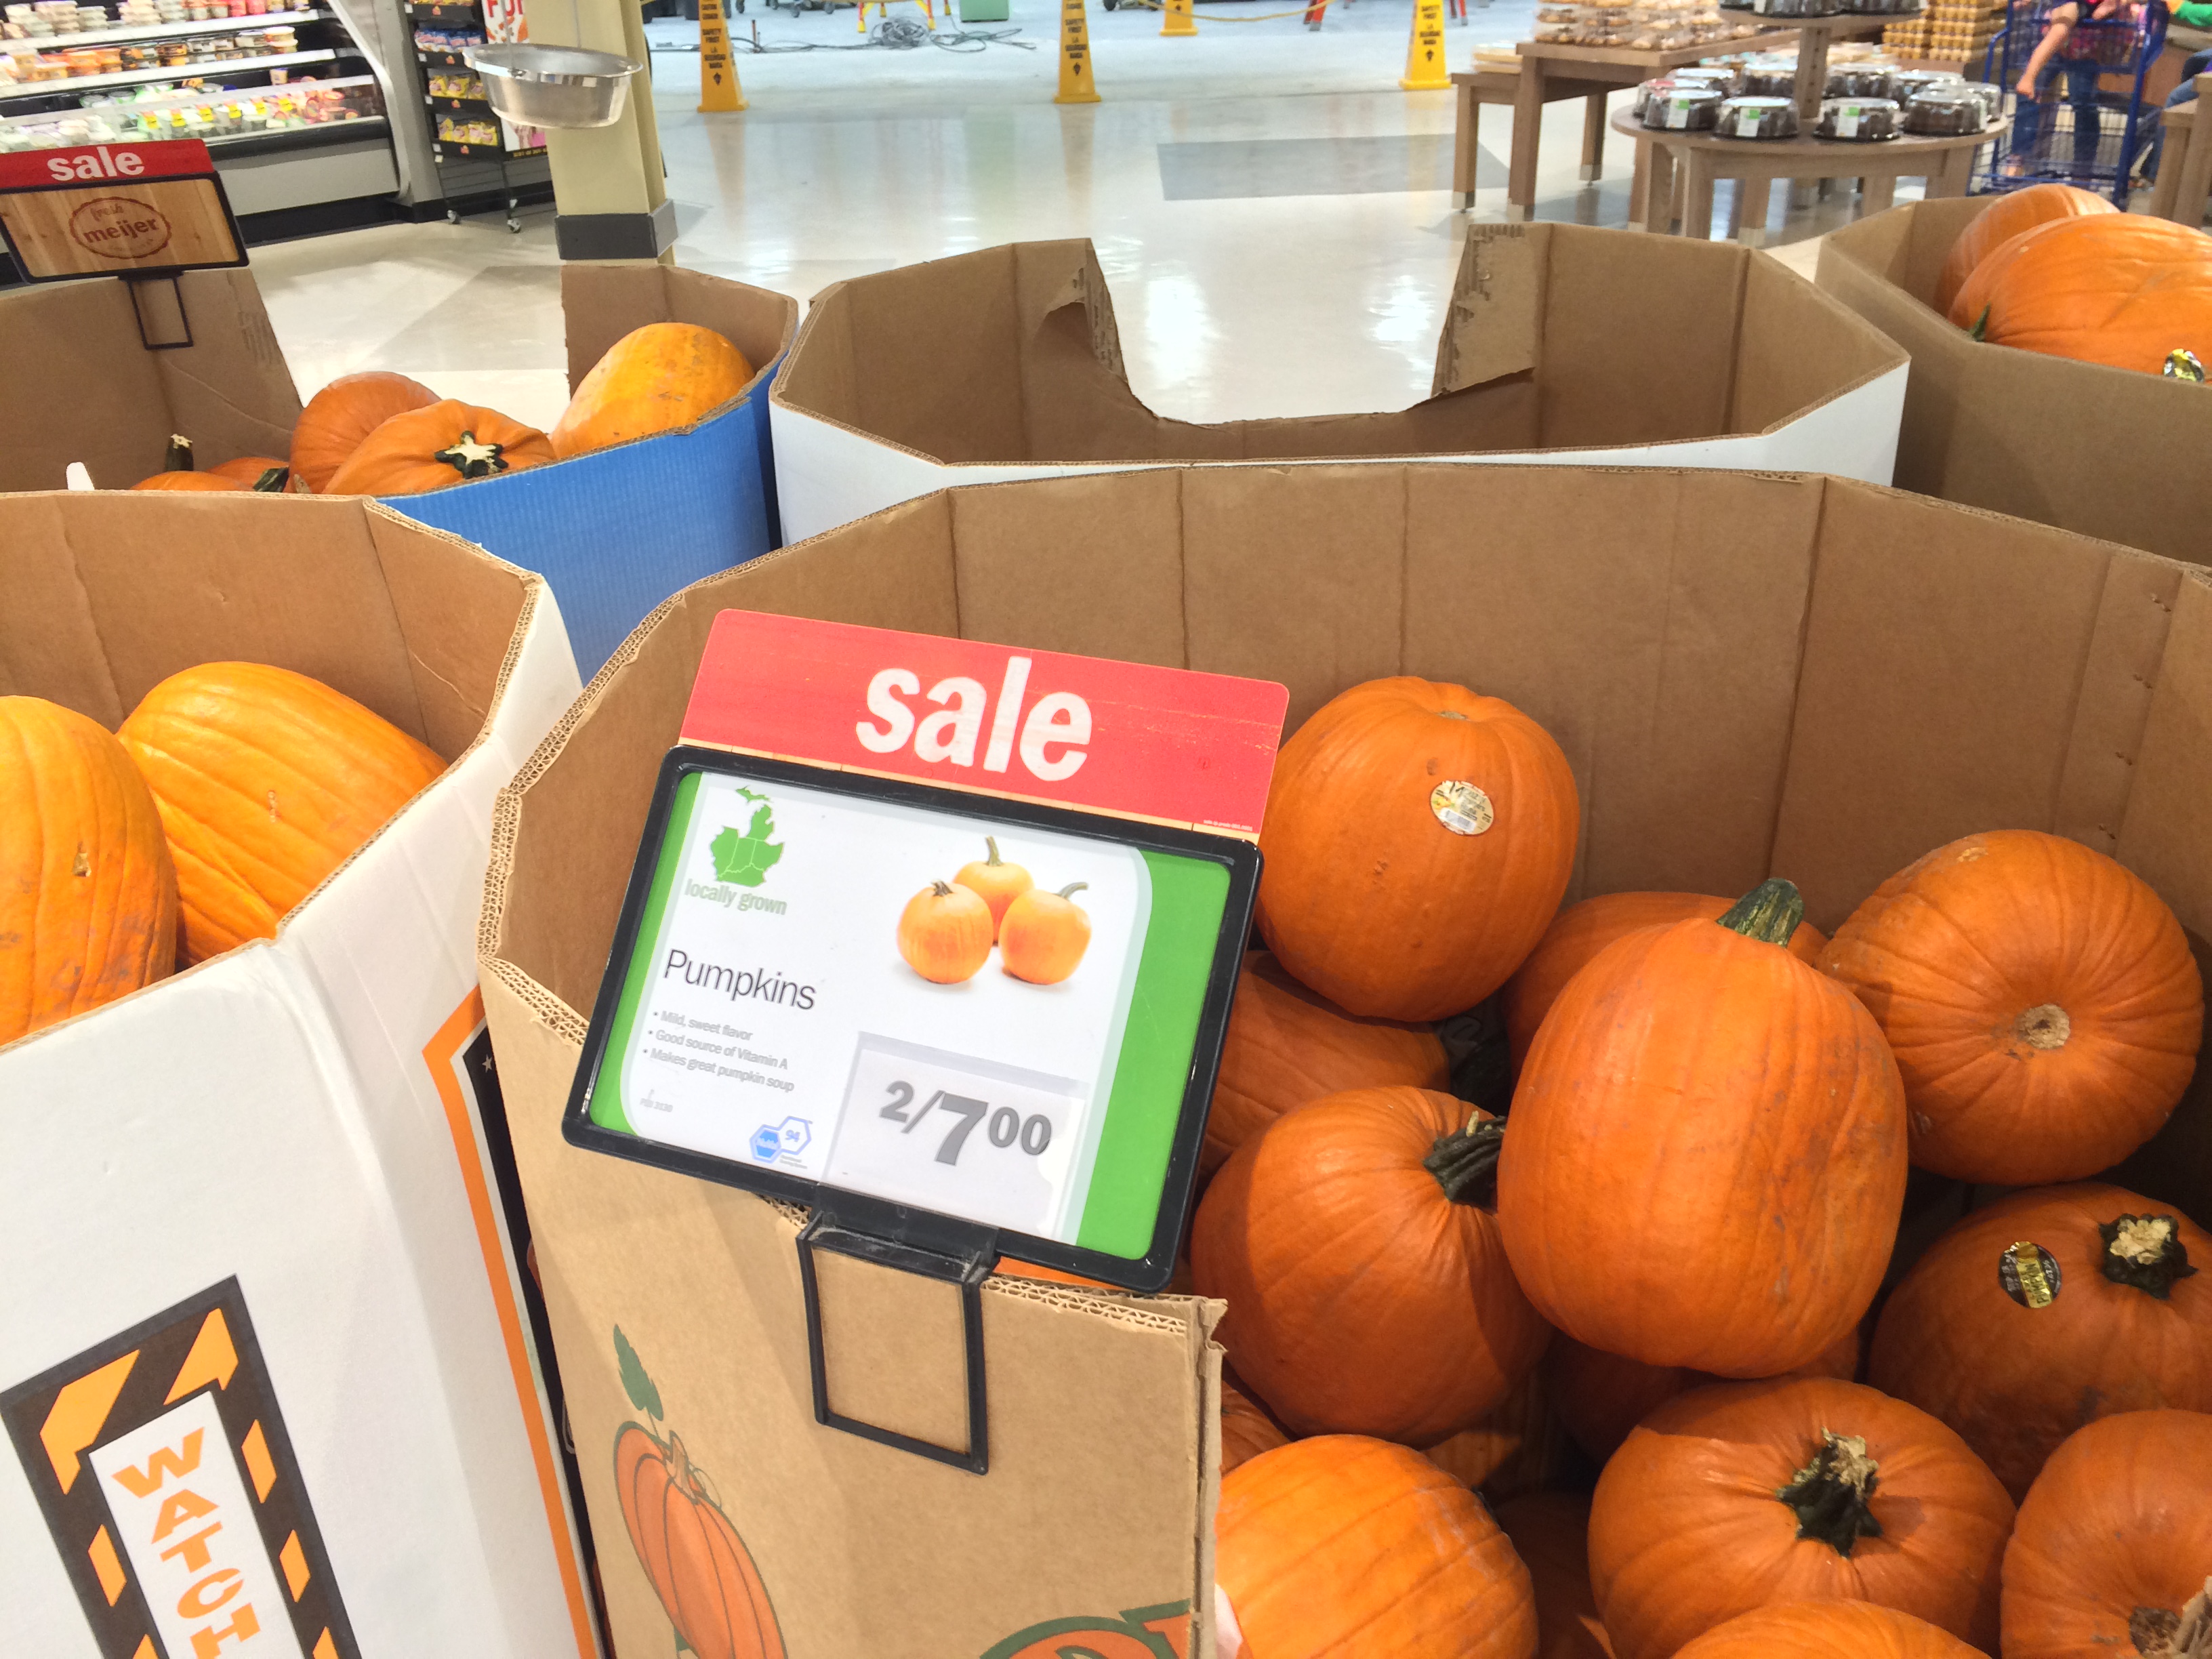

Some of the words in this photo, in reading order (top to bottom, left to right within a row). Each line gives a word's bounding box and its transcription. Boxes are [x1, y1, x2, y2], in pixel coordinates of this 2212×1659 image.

[47, 146, 144, 181] sale
[83, 219, 159, 243] meijer
[856, 655, 1092, 781] sale
[684, 878, 737, 908] locally
[737, 893, 787, 916] grown
[663, 949, 817, 1010] Pumpkins
[660, 1010, 687, 1027] Mild,
[688, 1018, 722, 1034] sweet
[722, 1025, 753, 1041] flavor
[650, 1048, 687, 1066] Makes
[687, 1058, 717, 1073] great
[716, 1065, 765, 1085] pumpkin
[766, 1077, 795, 1092] soup
[655, 1029, 685, 1046] Good
[685, 1038, 722, 1054] source
[723, 1046, 737, 1057] of
[737, 1048, 779, 1067] Vitamin
[778, 1058, 788, 1070] A
[111, 1427, 261, 1659] WATCH
